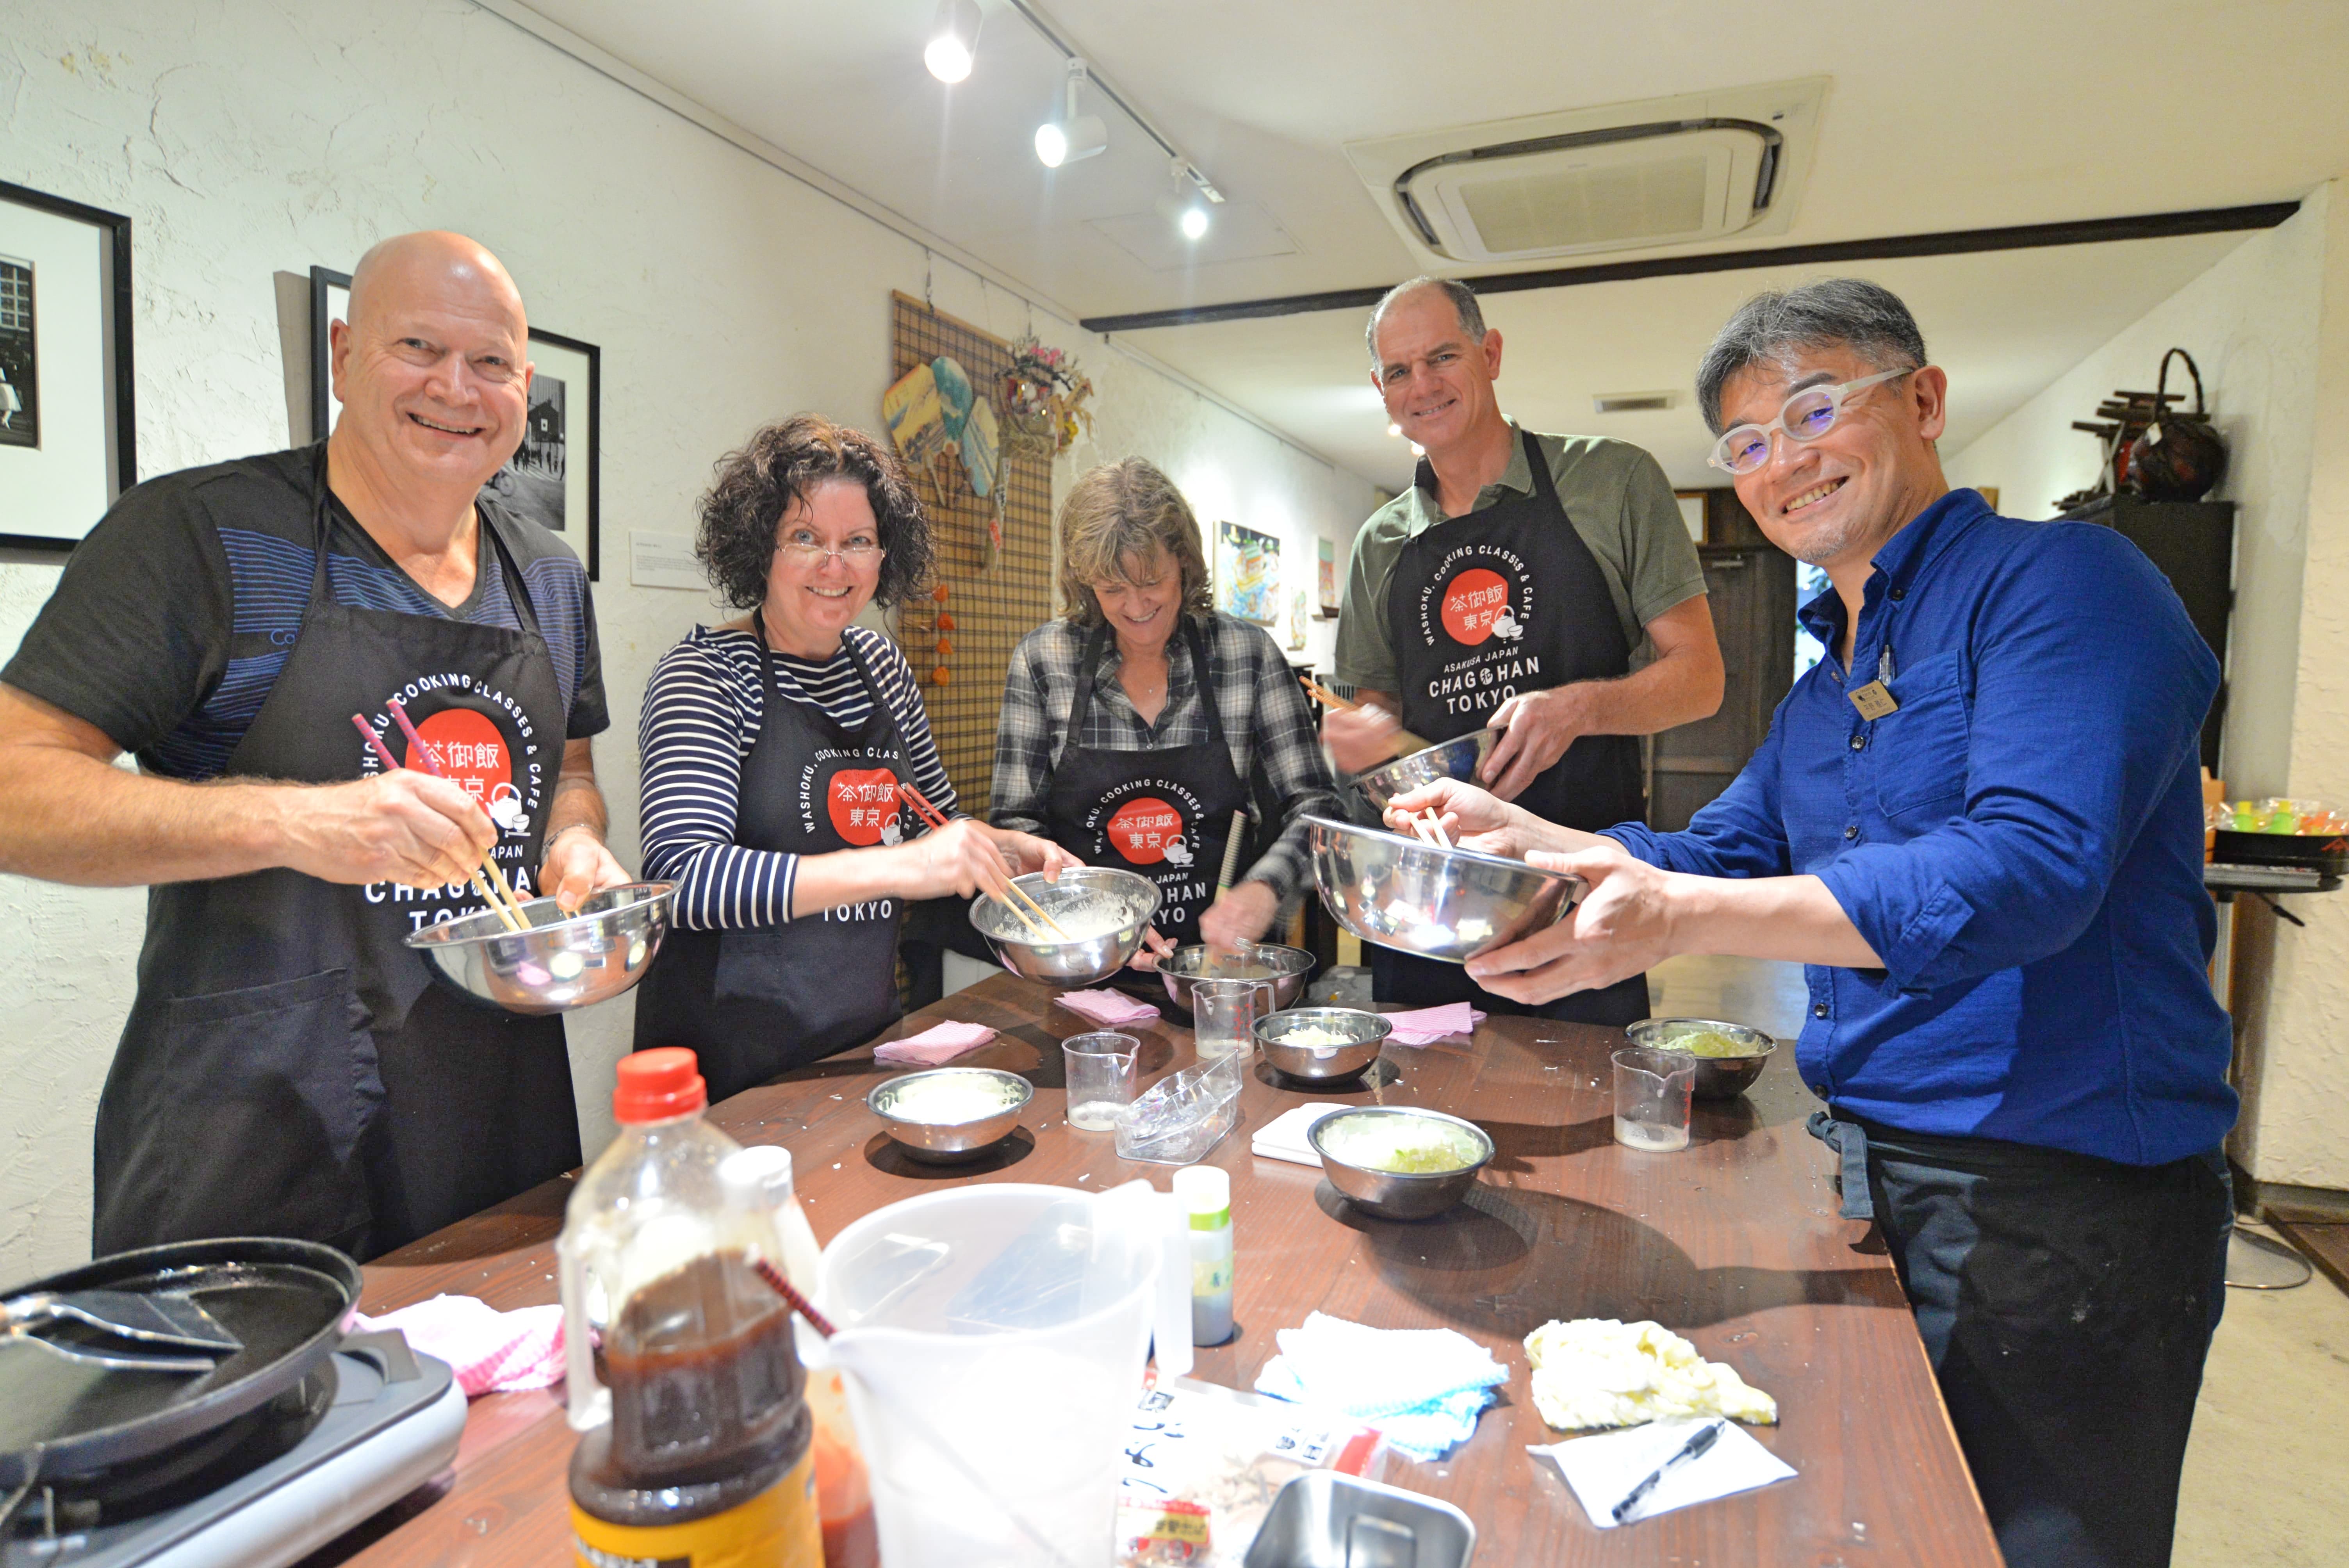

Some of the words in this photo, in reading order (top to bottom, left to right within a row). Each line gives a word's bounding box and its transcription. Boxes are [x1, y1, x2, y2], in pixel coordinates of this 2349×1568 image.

[1421, 586, 1435, 645] WASHOKU,
[1434, 546, 1472, 581] COOKING
[1479, 545, 1524, 571] CLASSES
[1520, 587, 1533, 619] CAFE
[1450, 584, 1503, 612] 茶御飯
[1463, 609, 1493, 631] 東京
[1444, 655, 1481, 673] ASAKUSA
[1485, 646, 1518, 661] JAPAN
[394, 674, 471, 706] COOKING
[1447, 685, 1516, 714] TOKYO
[474, 681, 533, 738] CLASSES
[527, 745, 537, 755] &
[527, 763, 541, 809] CAFE
[800, 764, 818, 833] WASHOKU,
[815, 748, 860, 761] COOKING
[867, 747, 898, 759] CLAS
[904, 805, 913, 830] AFE
[838, 782, 894, 802] 茶御飯
[1101, 779, 1150, 803] COOKING
[1157, 780, 1201, 810] CLASSES
[850, 807, 880, 827] 東京
[1116, 814, 1174, 829] 茶御飯
[489, 845, 523, 859] APAN
[1129, 831, 1161, 849] 東京
[1156, 872, 1188, 884] JAPAN
